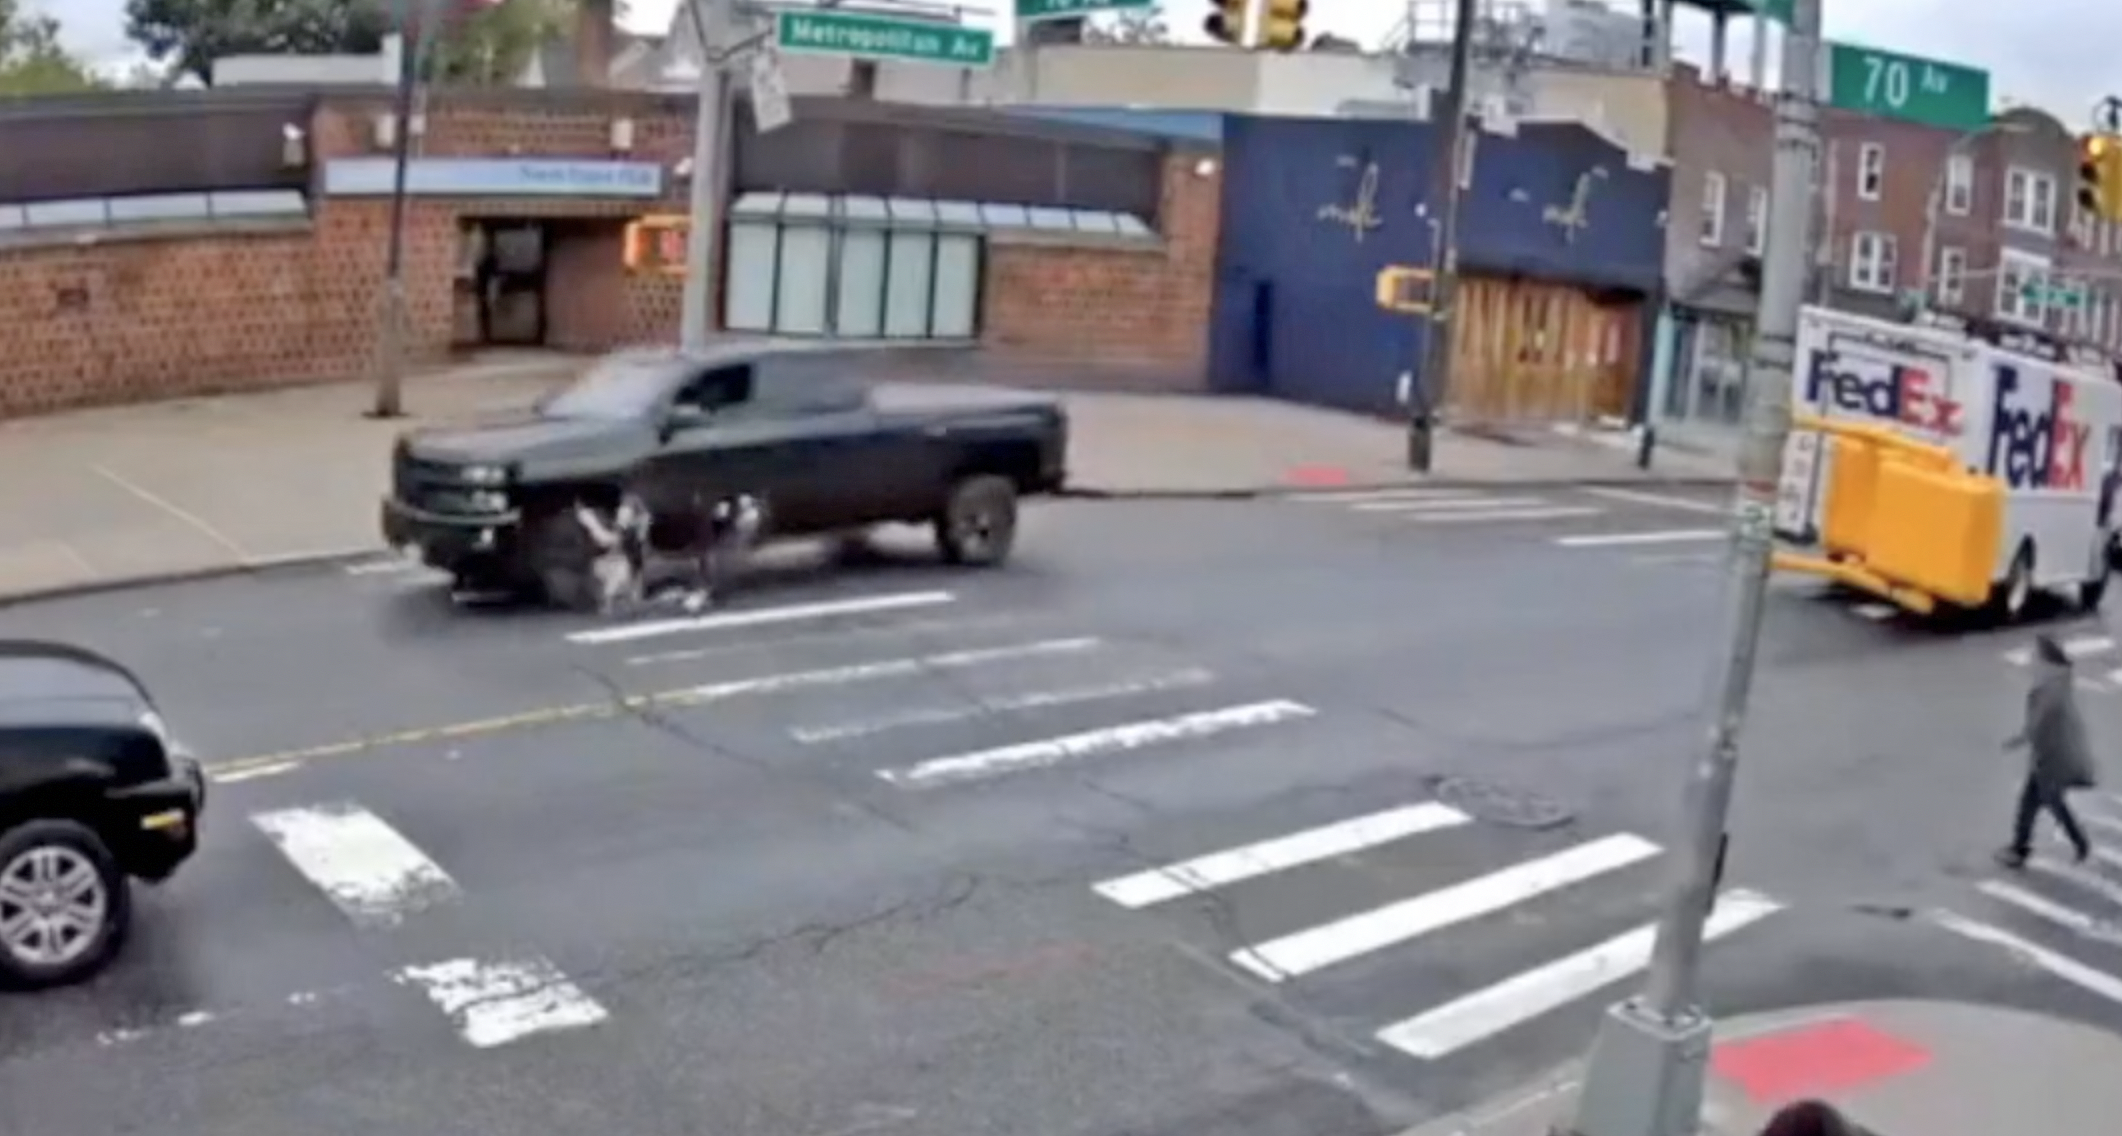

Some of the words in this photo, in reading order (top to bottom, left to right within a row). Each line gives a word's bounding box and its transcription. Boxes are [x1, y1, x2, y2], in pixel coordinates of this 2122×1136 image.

[790, 18, 941, 53] Metropolitan
[1863, 56, 1910, 108] 70
[1919, 64, 1949, 94] Av
[1806, 348, 1965, 436] FedEx
[1986, 364, 2091, 490] FedEx
